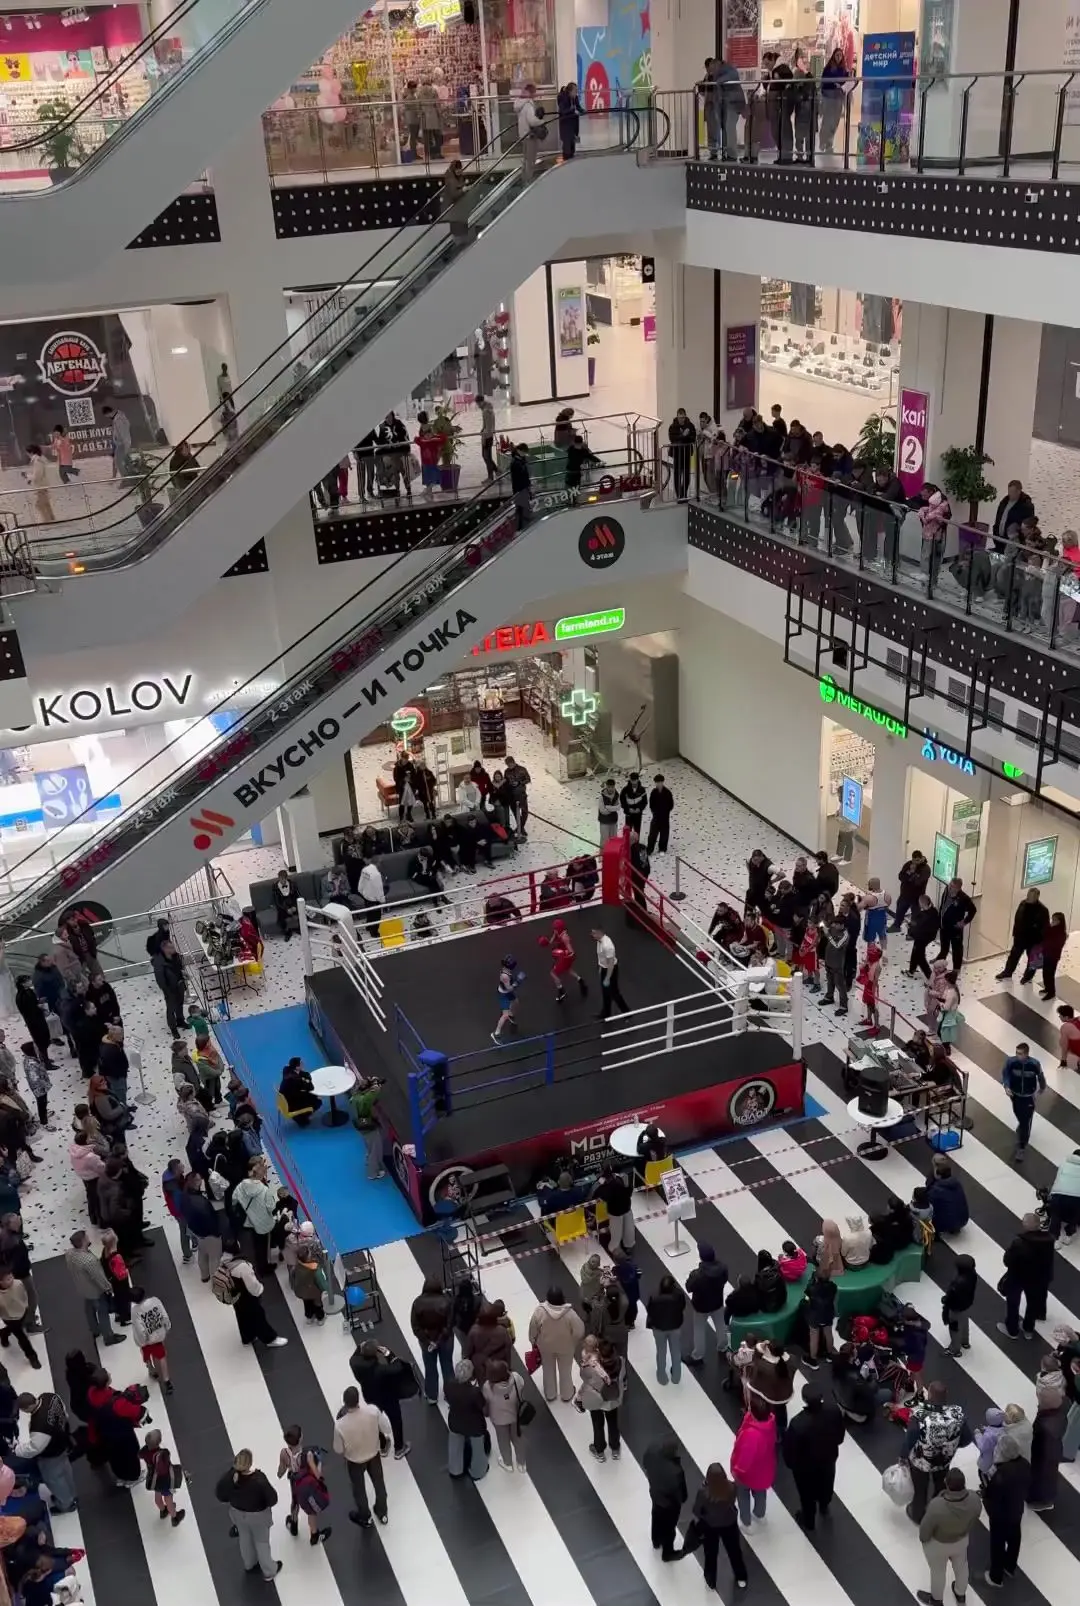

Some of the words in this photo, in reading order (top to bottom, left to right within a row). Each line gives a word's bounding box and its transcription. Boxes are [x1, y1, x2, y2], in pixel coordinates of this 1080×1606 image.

[864, 50, 898, 61] детский
[872, 60, 889, 68] мир
[47, 356, 101, 377] ЛЕГЕНДА
[902, 405, 926, 428] kari
[905, 438, 917, 466] 2
[530, 498, 541, 513] 2
[544, 485, 582, 507] этаж
[400, 600, 413, 614] 2
[412, 573, 447, 605] этаж
[484, 620, 549, 653] ТЕКА
[38, 675, 192, 727] KOLOV
[233, 718, 340, 809] ВКУСНО
[360, 678, 388, 706] И
[384, 608, 478, 683] ТОЧКА
[266, 708, 280, 722] 2
[279, 679, 315, 712] этаж
[144, 787, 180, 819] этаж
